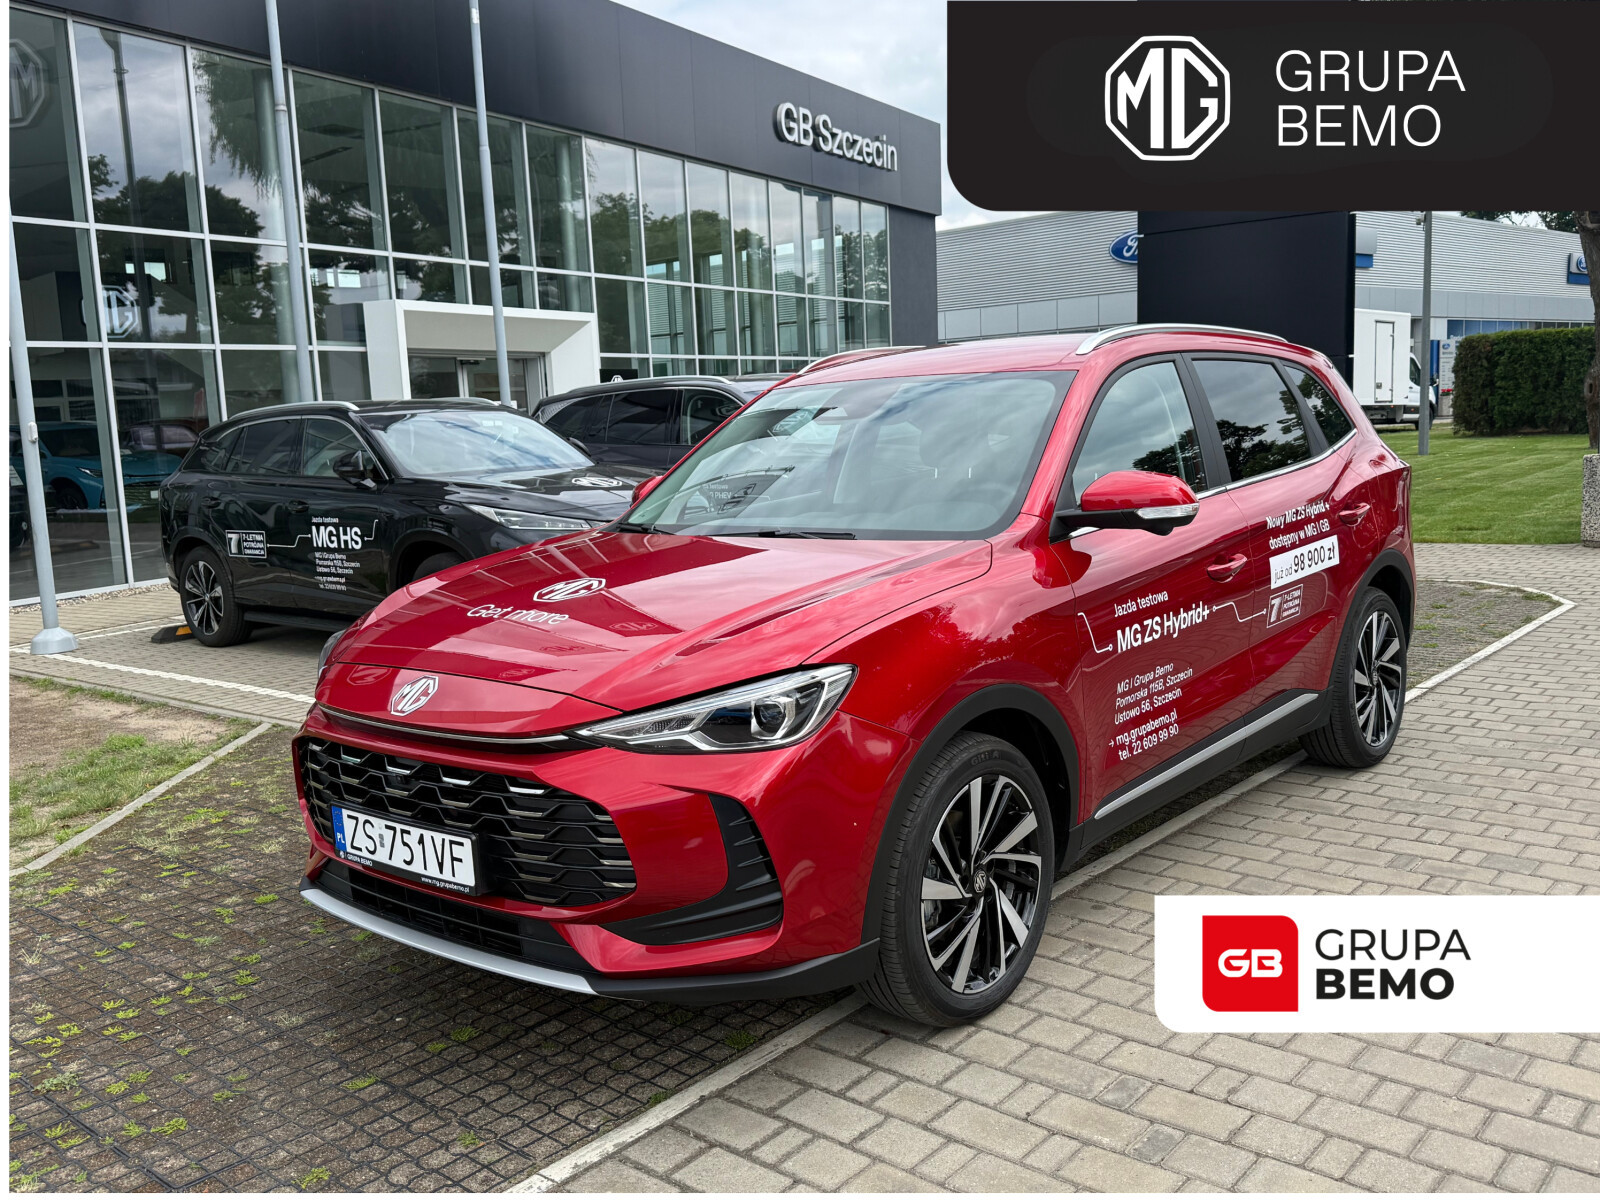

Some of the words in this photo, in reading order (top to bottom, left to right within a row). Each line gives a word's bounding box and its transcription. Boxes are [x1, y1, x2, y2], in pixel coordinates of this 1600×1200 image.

[777, 102, 813, 146] GB
[815, 114, 898, 171] Szczecin
[1265, 515, 1285, 529] Nowy
[1285, 508, 1296, 523] MG
[1297, 505, 1305, 520] ZS
[228, 533, 240, 554] 7
[312, 525, 338, 548] MG
[339, 526, 362, 550] HS
[1269, 534, 1299, 550] dostępny
[1298, 530, 1305, 539] w
[1304, 522, 1318, 538] MG
[1320, 518, 1330, 532] GB
[1274, 568, 1284, 584] już
[1284, 564, 1293, 578] od
[1293, 553, 1306, 573] 98
[1307, 546, 1326, 568] 900
[1327, 542, 1336, 561] zł
[466, 604, 513, 620] Get
[508, 607, 570, 625] more
[1114, 599, 1137, 618] Jazda
[1137, 590, 1169, 609] testowa
[1270, 596, 1282, 622] 7
[1116, 623, 1142, 653] MG
[1143, 616, 1162, 643] ZS
[394, 677, 436, 713] MG
[1115, 687, 1148, 710] Pomorska
[1149, 679, 1165, 694] 115B,
[1165, 667, 1193, 687] Szczecin
[1117, 679, 1129, 695] MG
[1133, 671, 1154, 687] Grupa
[1155, 663, 1174, 678] Bemo
[1114, 706, 1140, 725] Ustowo
[1141, 699, 1153, 713] 56,
[1153, 687, 1183, 707] Szczecin
[1115, 708, 1178, 745] mg.grupabemo.pl
[1118, 746, 1131, 761] tel.
[1131, 740, 1142, 755] 22
[1143, 733, 1158, 749] 609
[1158, 728, 1169, 742] 99
[1168, 723, 1179, 737] 90
[336, 832, 345, 843] PL
[347, 853, 361, 863] GRUPA
[360, 857, 373, 867] BEMO
